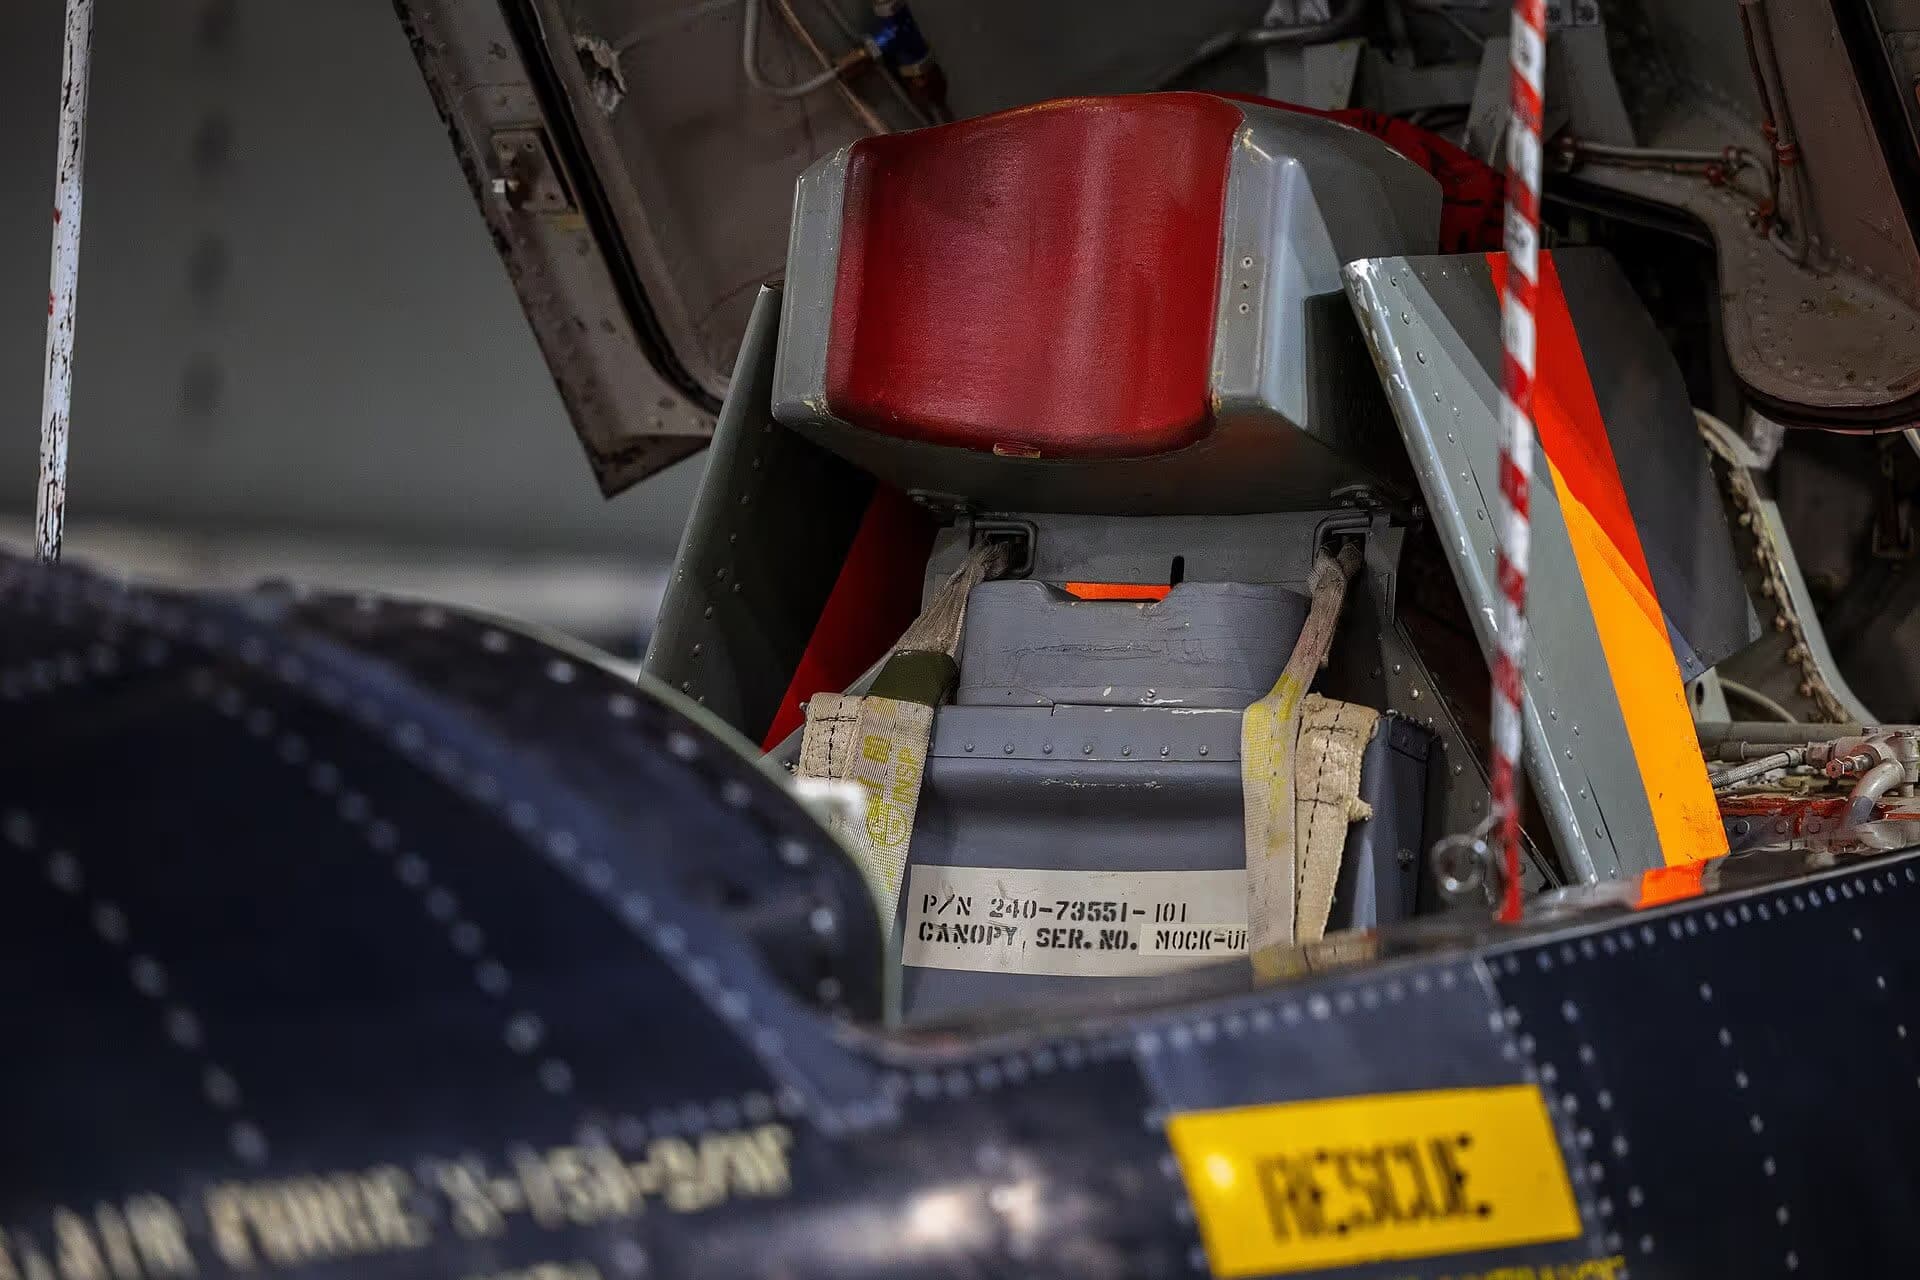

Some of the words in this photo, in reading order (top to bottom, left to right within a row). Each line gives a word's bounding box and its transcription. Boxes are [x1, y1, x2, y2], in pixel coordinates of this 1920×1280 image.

[922, 893, 972, 916] P/N
[918, 921, 1018, 946] CANOPY
[1035, 927, 1093, 950] SER.
[1099, 929, 1139, 951] NO.
[1255, 1131, 1492, 1246] RESCUE
